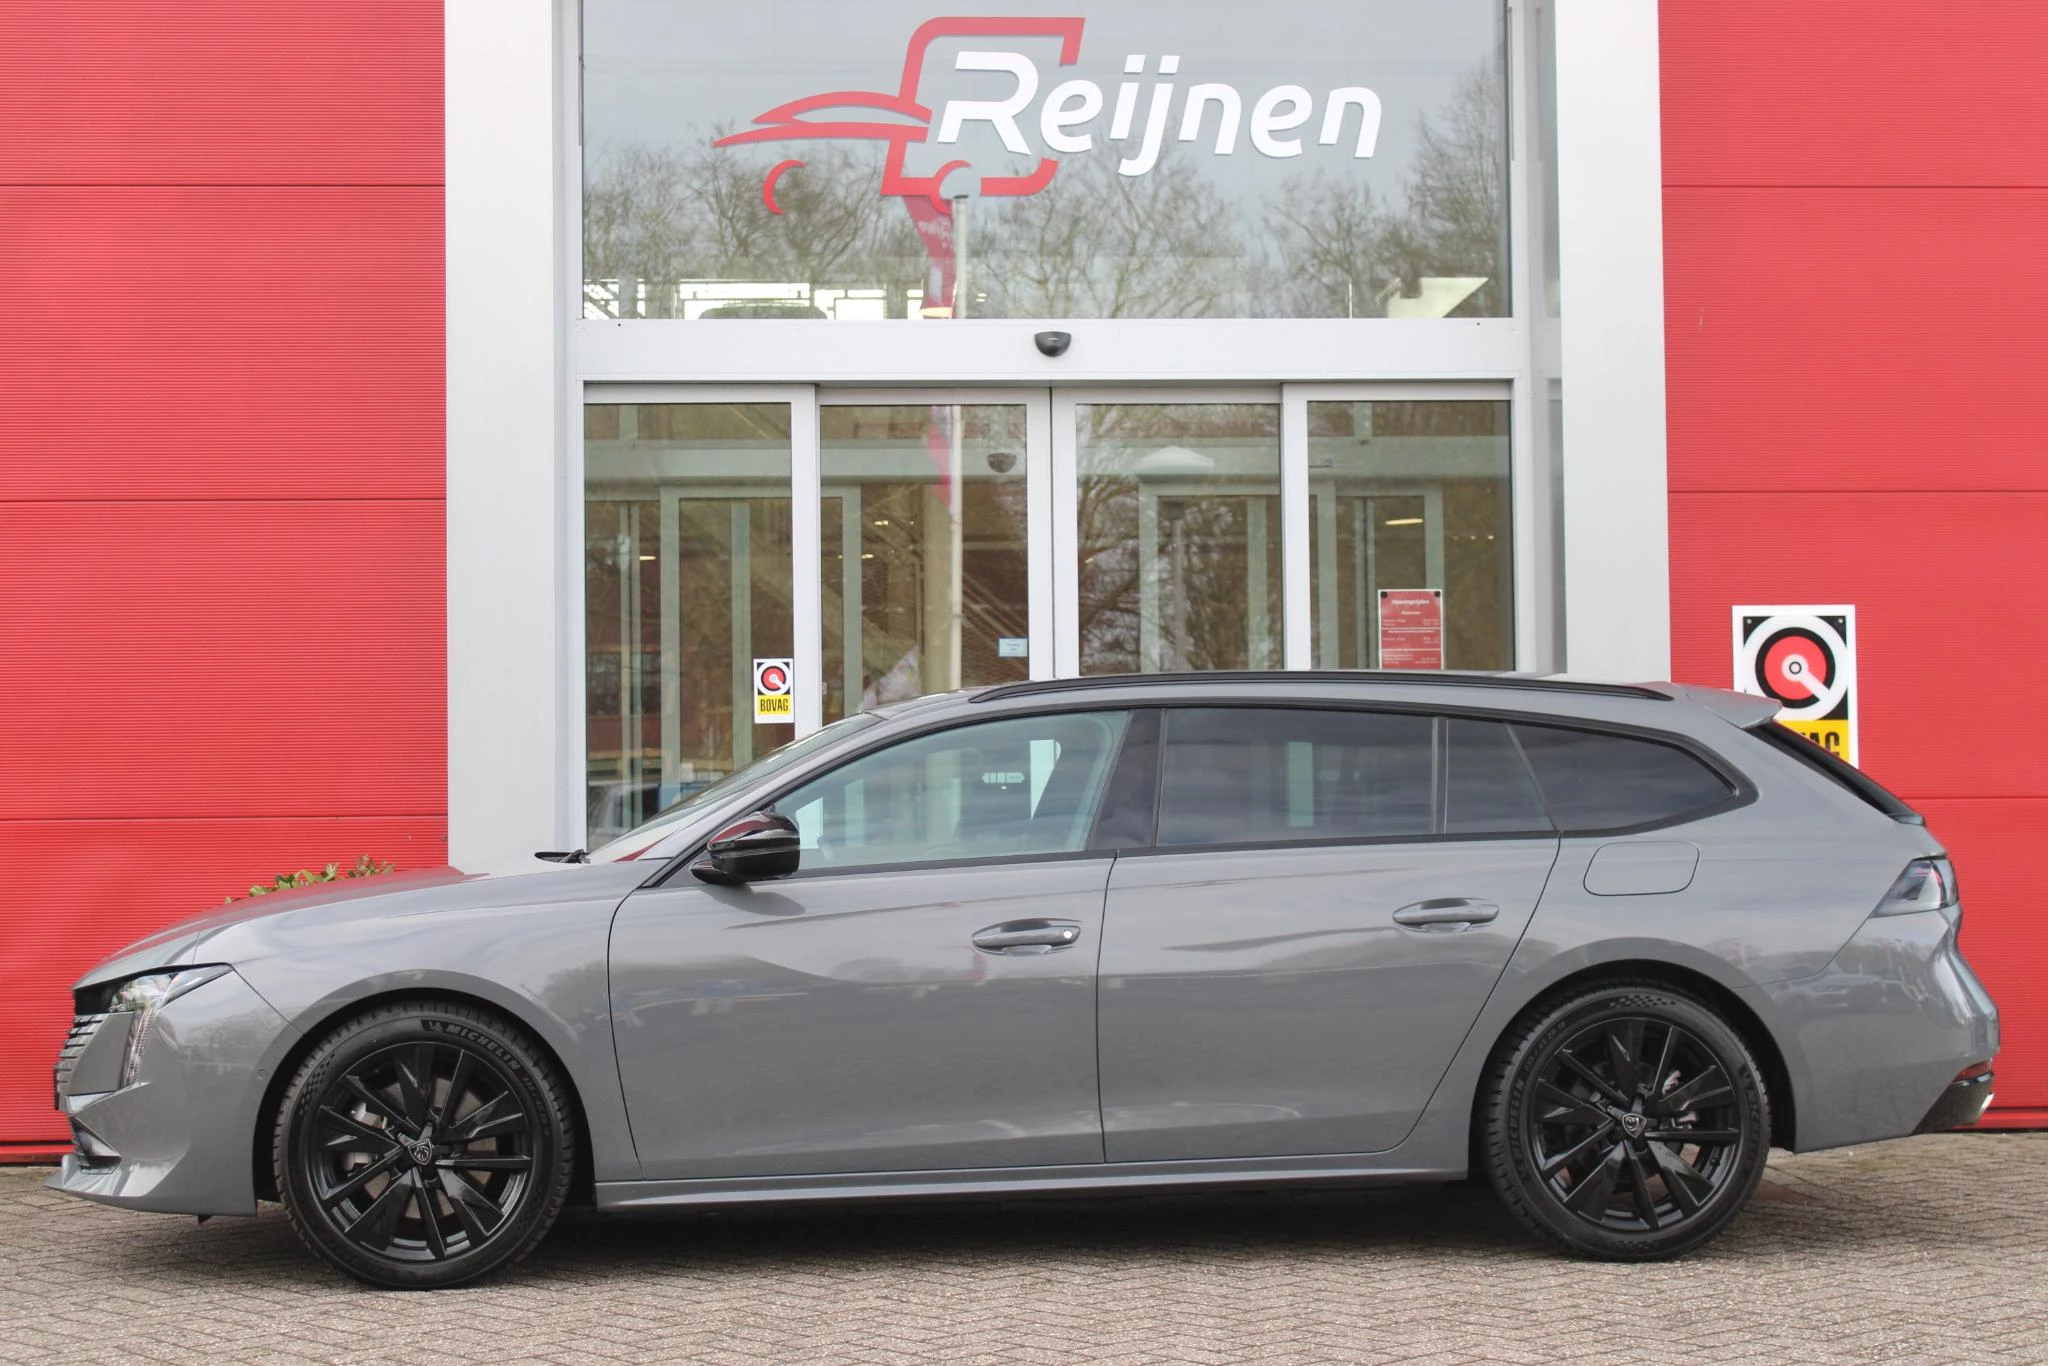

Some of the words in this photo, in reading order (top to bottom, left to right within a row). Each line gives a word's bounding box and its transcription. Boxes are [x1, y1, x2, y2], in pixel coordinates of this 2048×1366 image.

[937, 51, 1382, 177] Reijnen
[760, 698, 789, 712] BOVAG
[446, 1024, 521, 1071] MICHELIN
